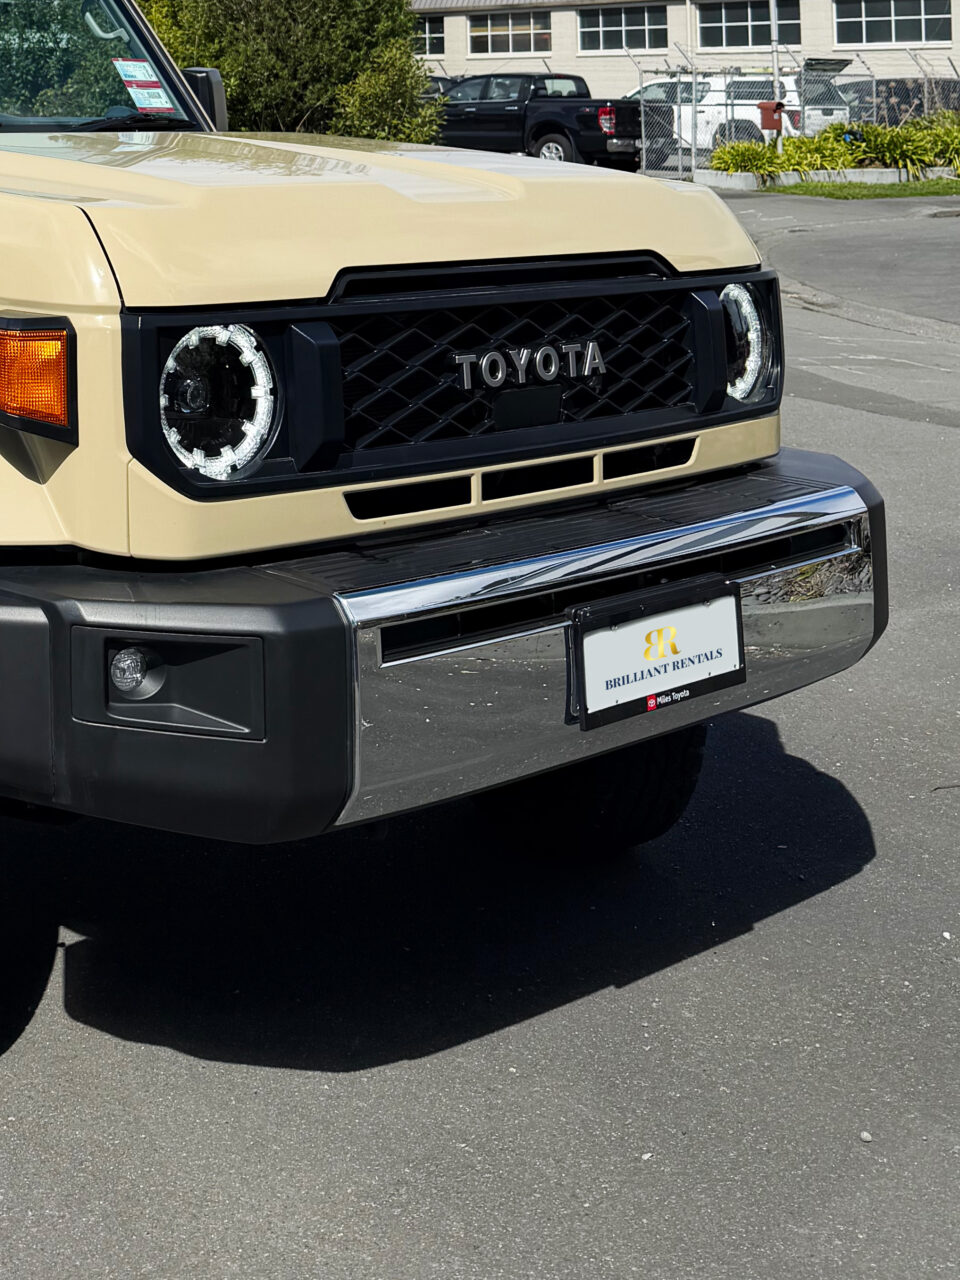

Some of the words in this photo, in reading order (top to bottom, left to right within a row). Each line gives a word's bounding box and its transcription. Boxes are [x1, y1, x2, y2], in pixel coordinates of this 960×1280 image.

[454, 341, 607, 390] TOYOTA
[605, 663, 670, 691] BRILLIANT
[672, 648, 723, 672] RENTALS
[656, 693, 672, 705] Miles
[672, 689, 690, 701] Toyota
